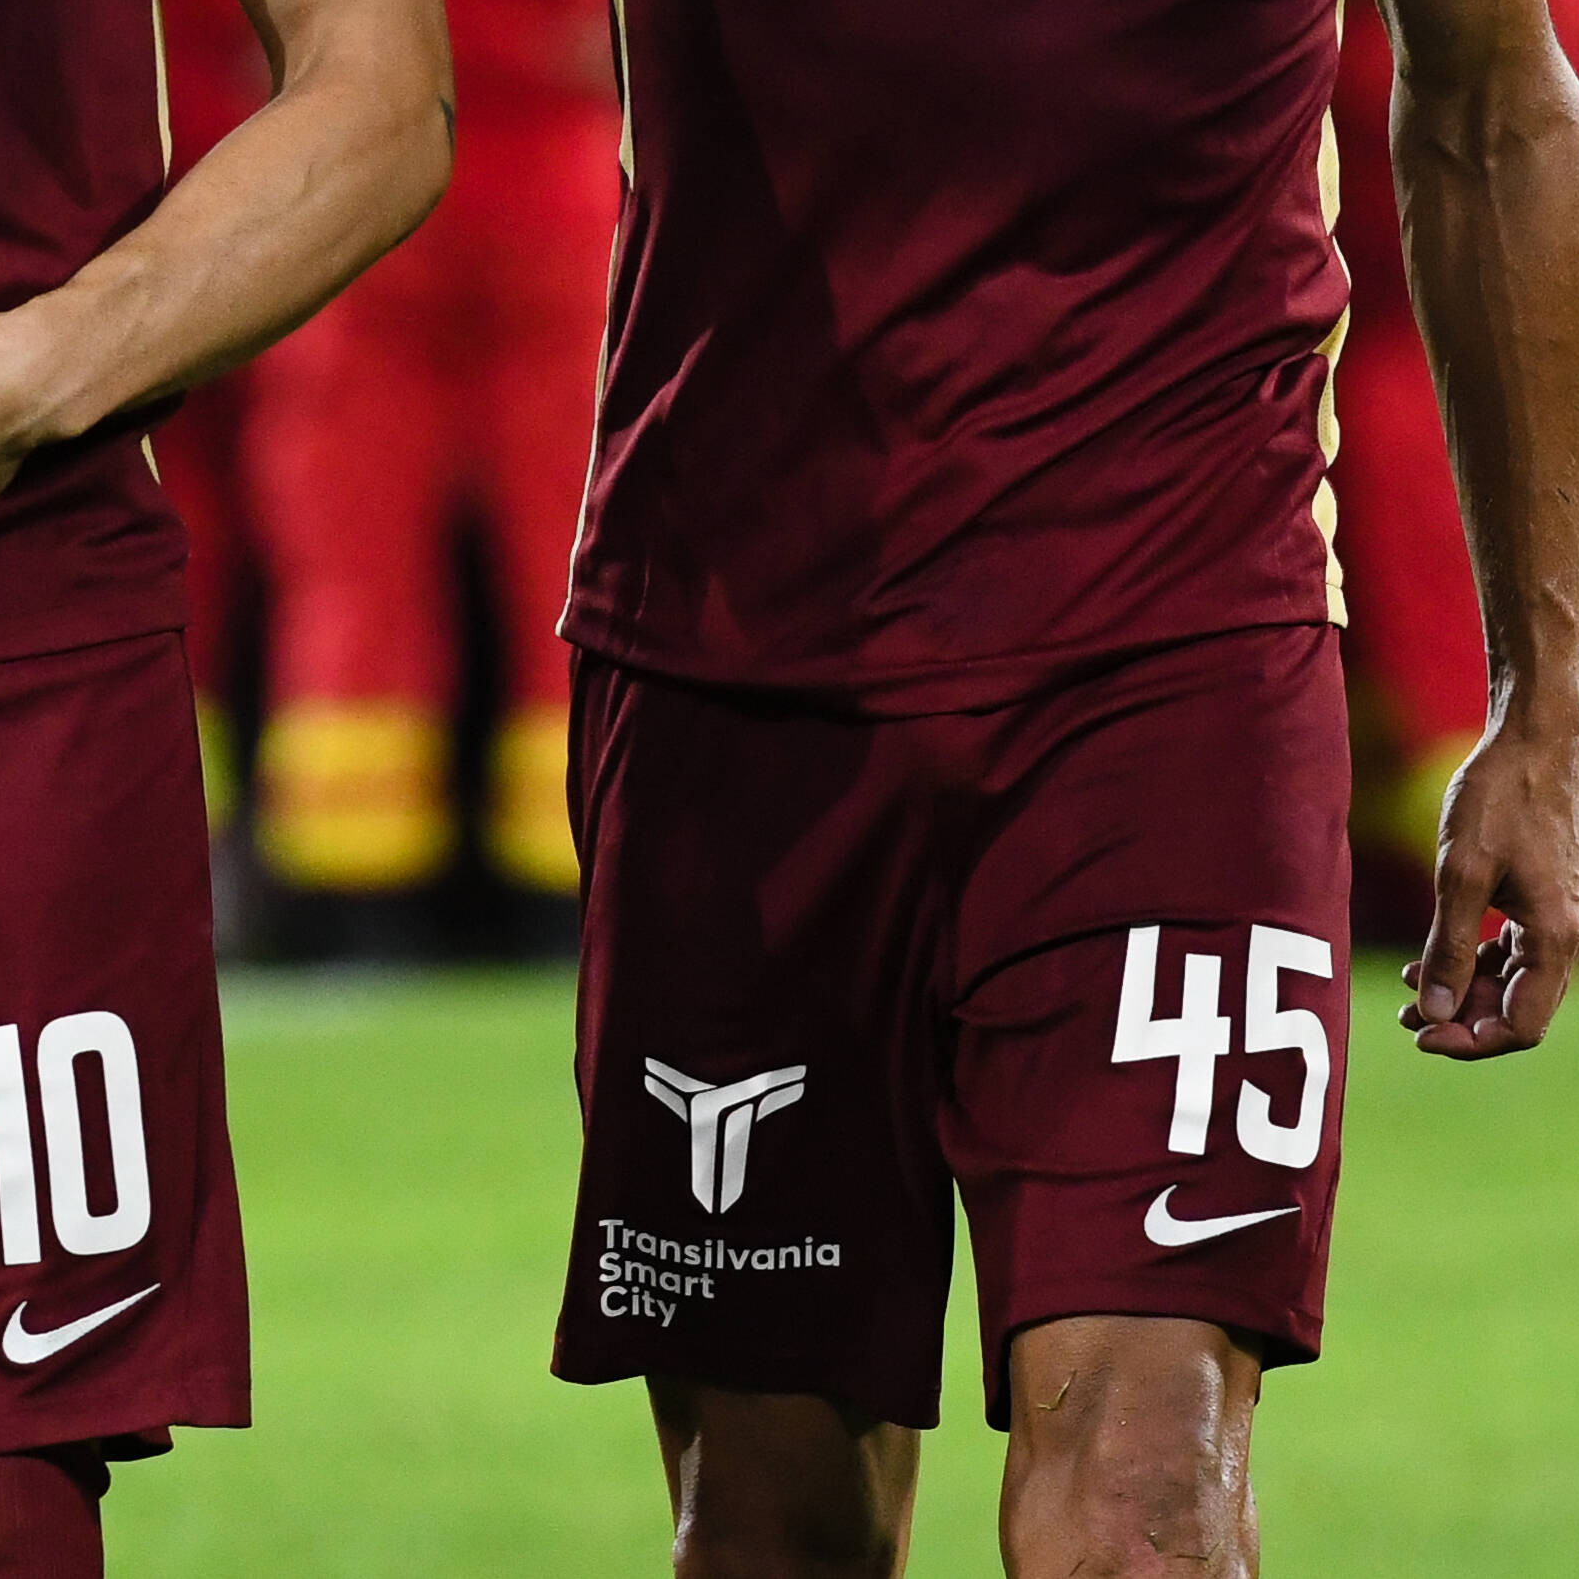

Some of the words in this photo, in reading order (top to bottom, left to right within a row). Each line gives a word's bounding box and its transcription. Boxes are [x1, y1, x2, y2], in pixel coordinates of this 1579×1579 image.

[1111, 923, 1334, 1169] 45
[598, 1219, 841, 1270] Transilvania
[599, 1252, 715, 1299] Smart
[600, 1285, 677, 1328] City
